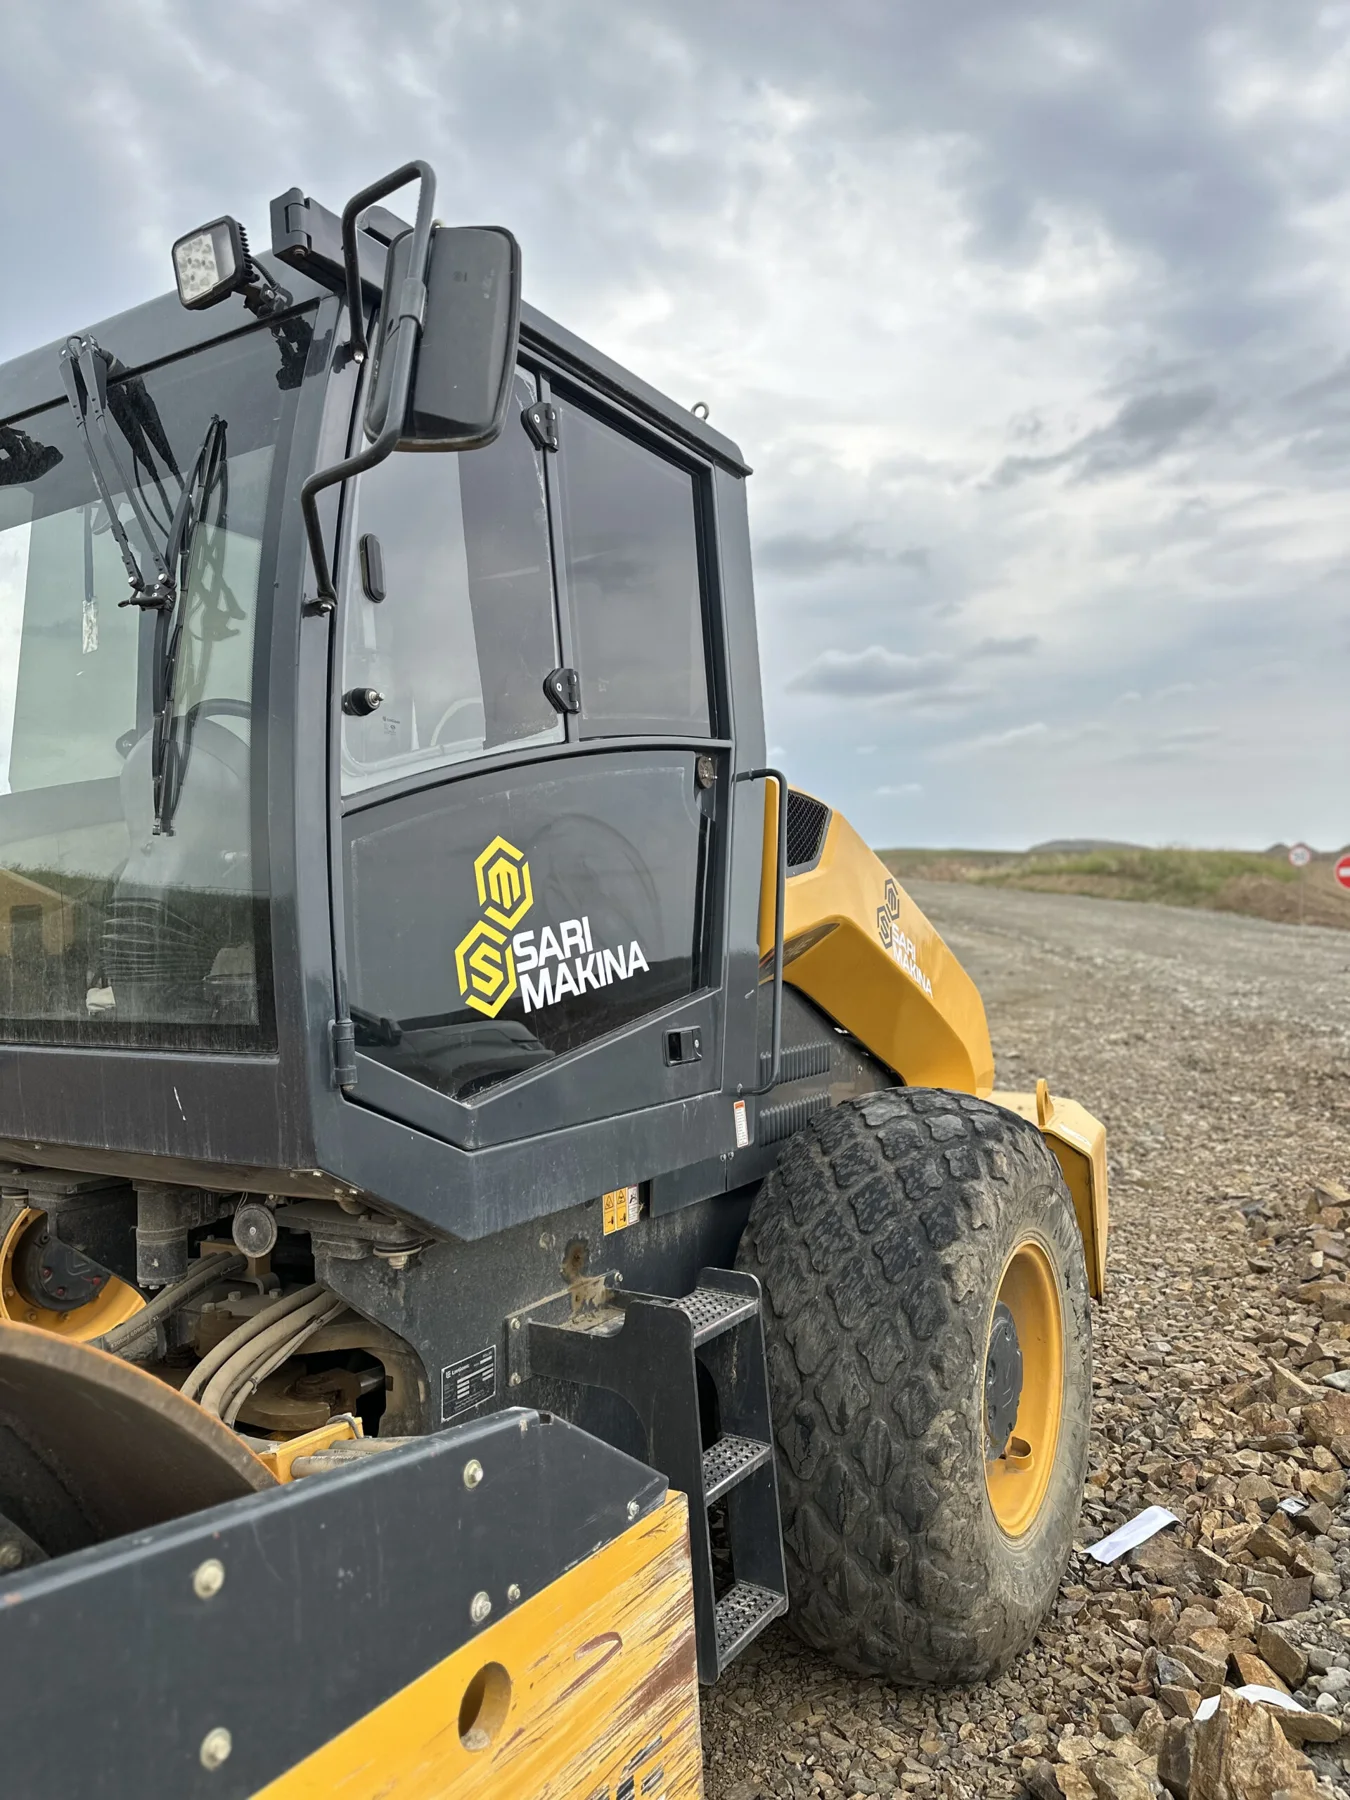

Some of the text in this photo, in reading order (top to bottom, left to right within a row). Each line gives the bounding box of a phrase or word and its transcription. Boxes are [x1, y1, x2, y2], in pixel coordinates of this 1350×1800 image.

[513, 916, 593, 973] SARI
[891, 922, 916, 961] SARI
[519, 940, 650, 1013] MAKINA
[892, 943, 933, 999] MAKINA
